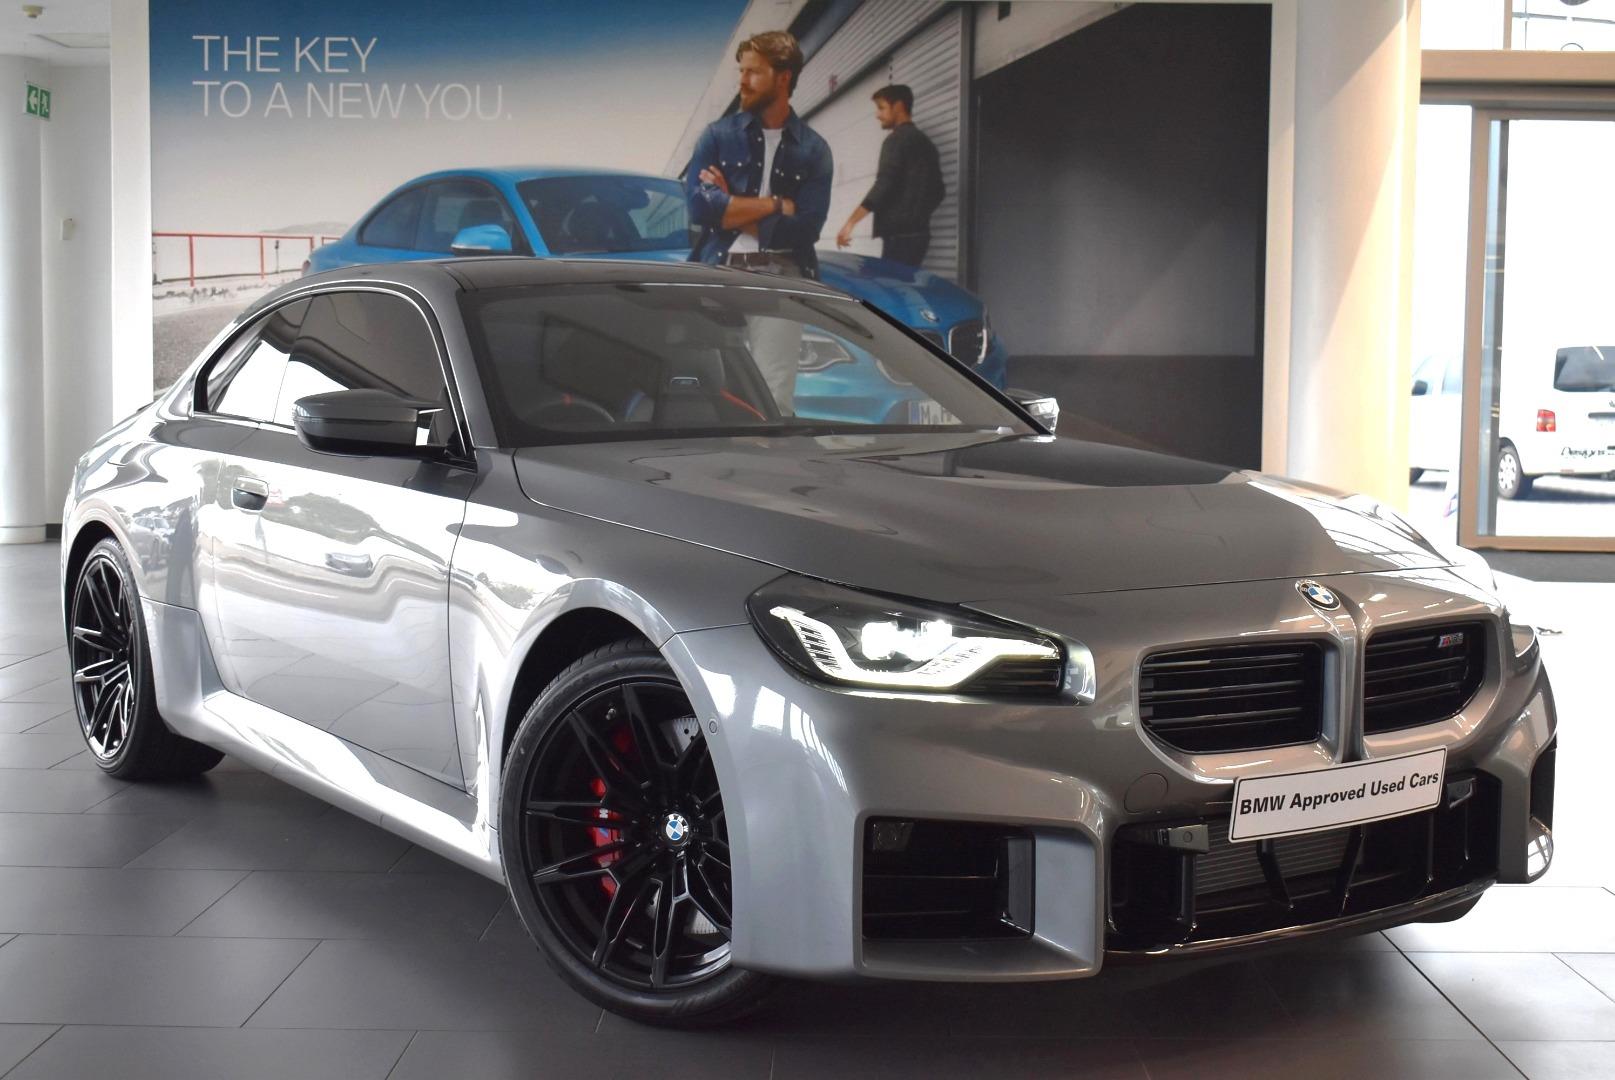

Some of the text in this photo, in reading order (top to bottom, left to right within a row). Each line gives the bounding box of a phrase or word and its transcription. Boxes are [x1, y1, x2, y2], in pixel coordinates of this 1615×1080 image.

[192, 35, 378, 73] THE KEY
[192, 80, 512, 120] TO A NEW YOU.
[1240, 770, 1439, 816] BMW Approved Used Cars
